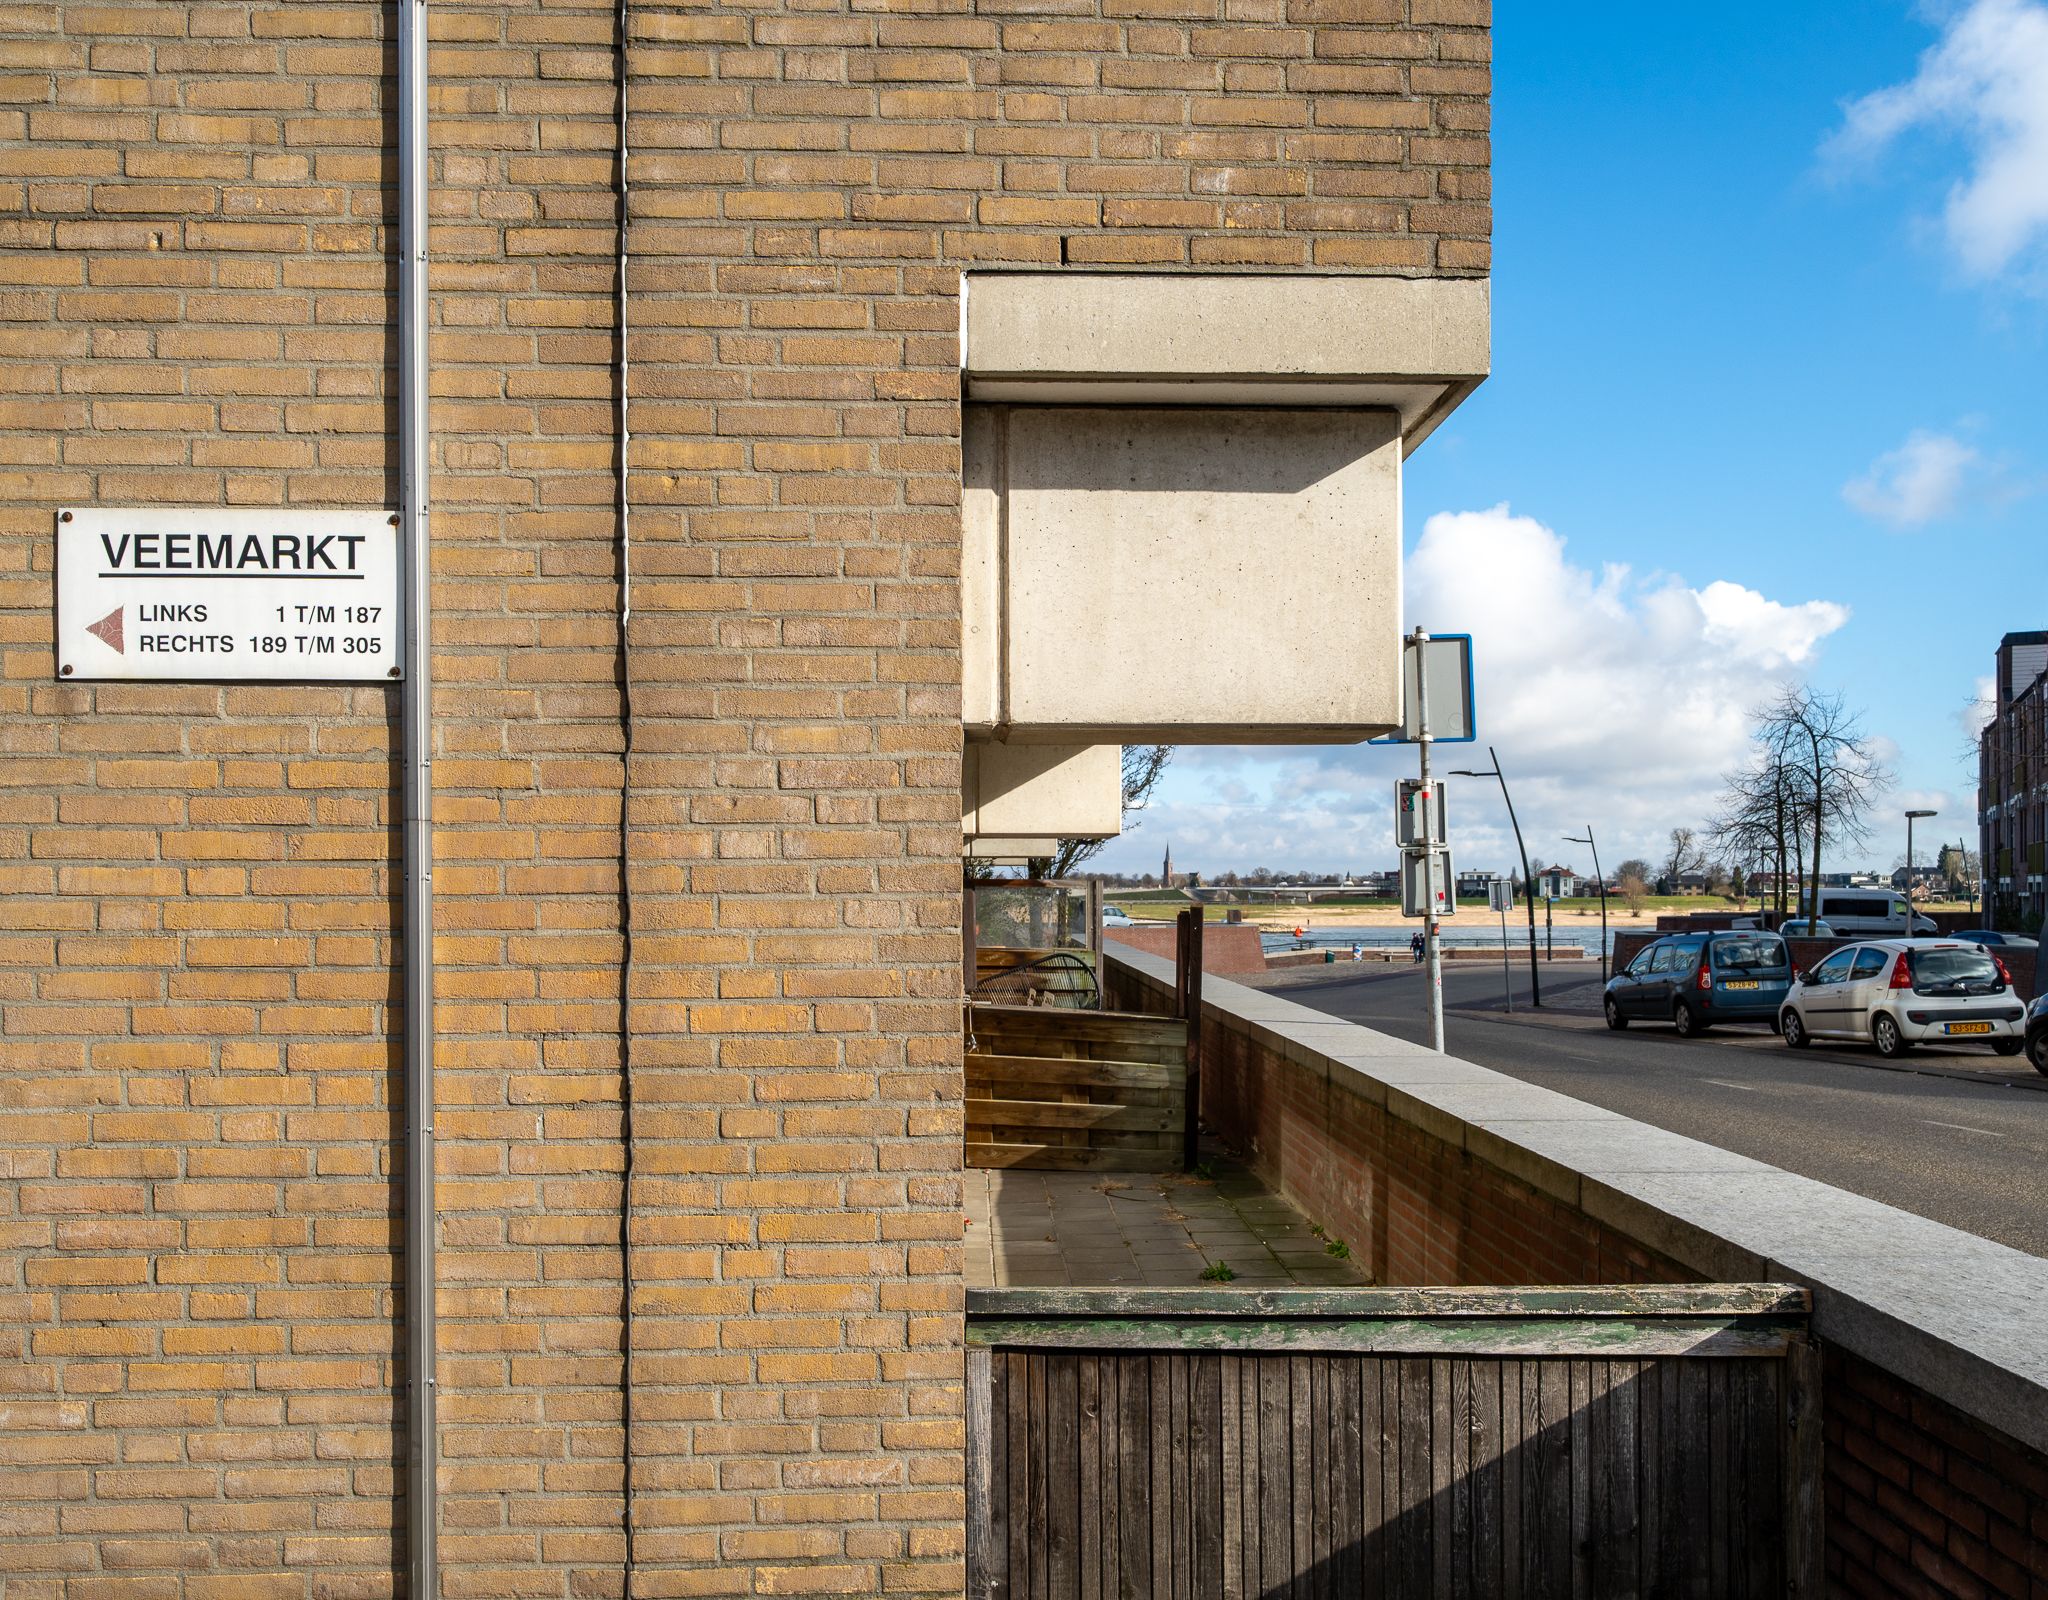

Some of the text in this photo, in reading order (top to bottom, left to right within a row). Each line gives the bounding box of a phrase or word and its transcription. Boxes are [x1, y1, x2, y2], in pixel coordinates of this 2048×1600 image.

[100, 533, 366, 570] VEEMARKT
[139, 604, 382, 625] LINKS 1 T/M 187
[140, 635, 382, 655] RECHTS 189 T/M 305
